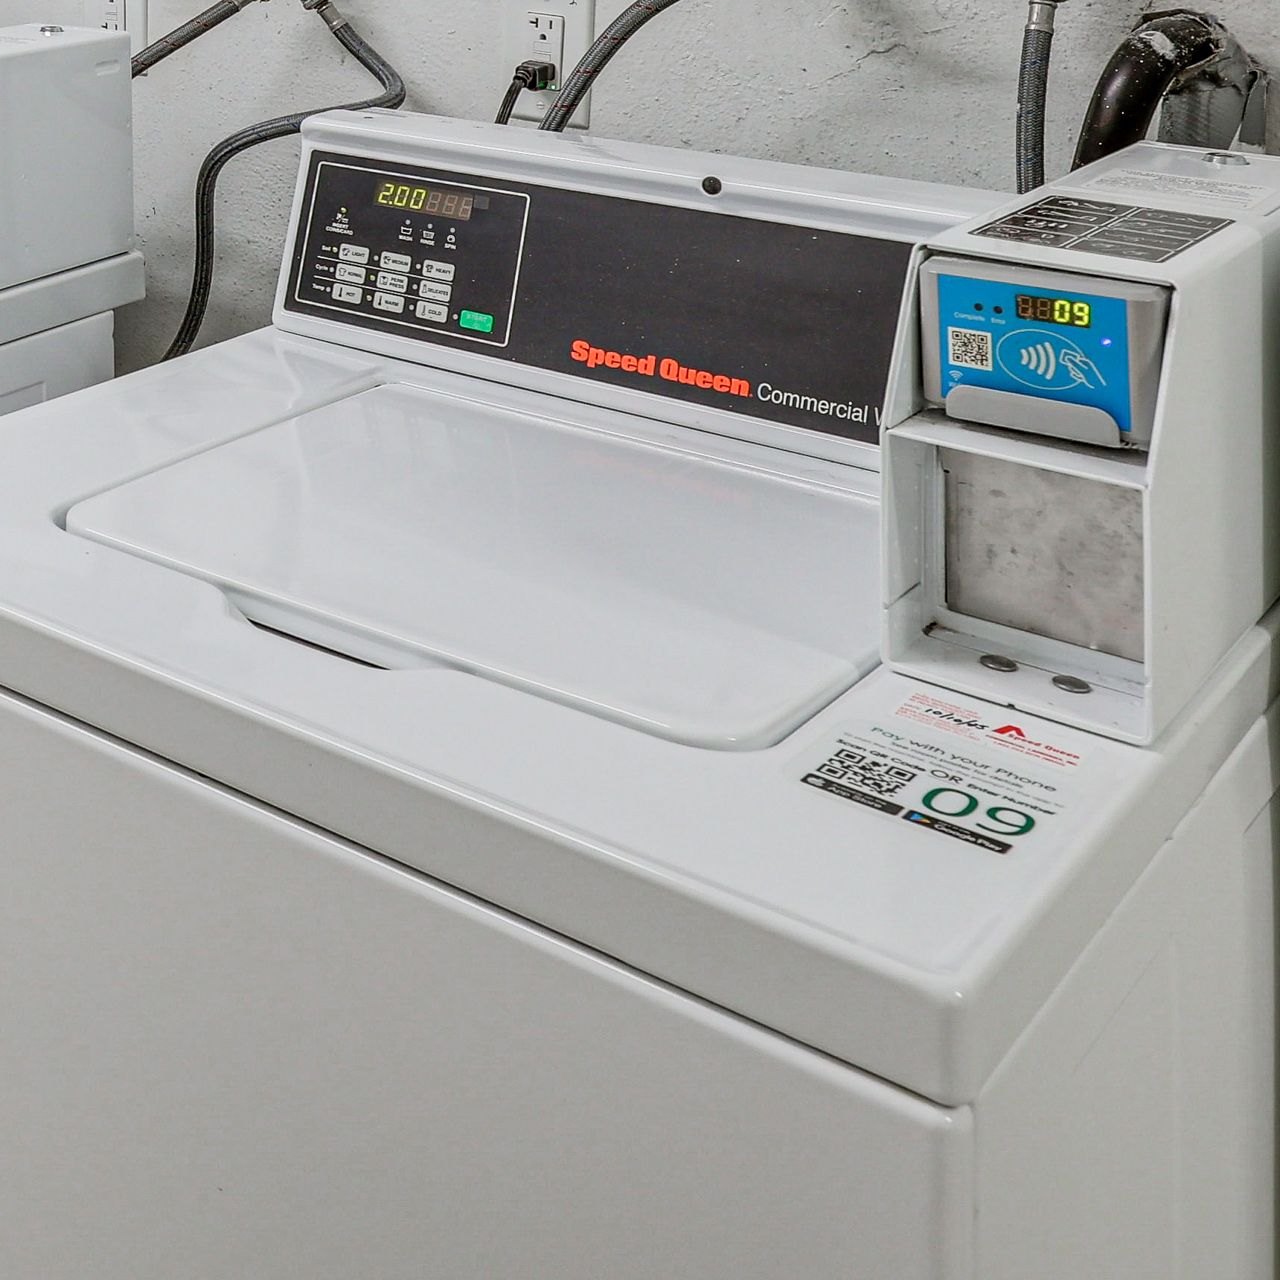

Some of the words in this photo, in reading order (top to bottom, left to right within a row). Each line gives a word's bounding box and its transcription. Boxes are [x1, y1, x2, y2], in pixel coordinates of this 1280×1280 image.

[378, 183, 426, 210] 2.00
[1053, 299, 1090, 326] 09
[571, 340, 656, 376] Speed
[660, 358, 753, 398] Queen
[757, 383, 869, 424] Commercial
[835, 738, 867, 751] Scan
[870, 749, 889, 759] QR
[891, 757, 927, 772] Code
[930, 769, 964, 785] OR
[871, 727, 903, 741] Pay
[910, 738, 946, 755] with
[951, 751, 993, 770] your
[996, 768, 1057, 792] Phone
[922, 787, 1036, 836] 09
[934, 823, 975, 843] Google
